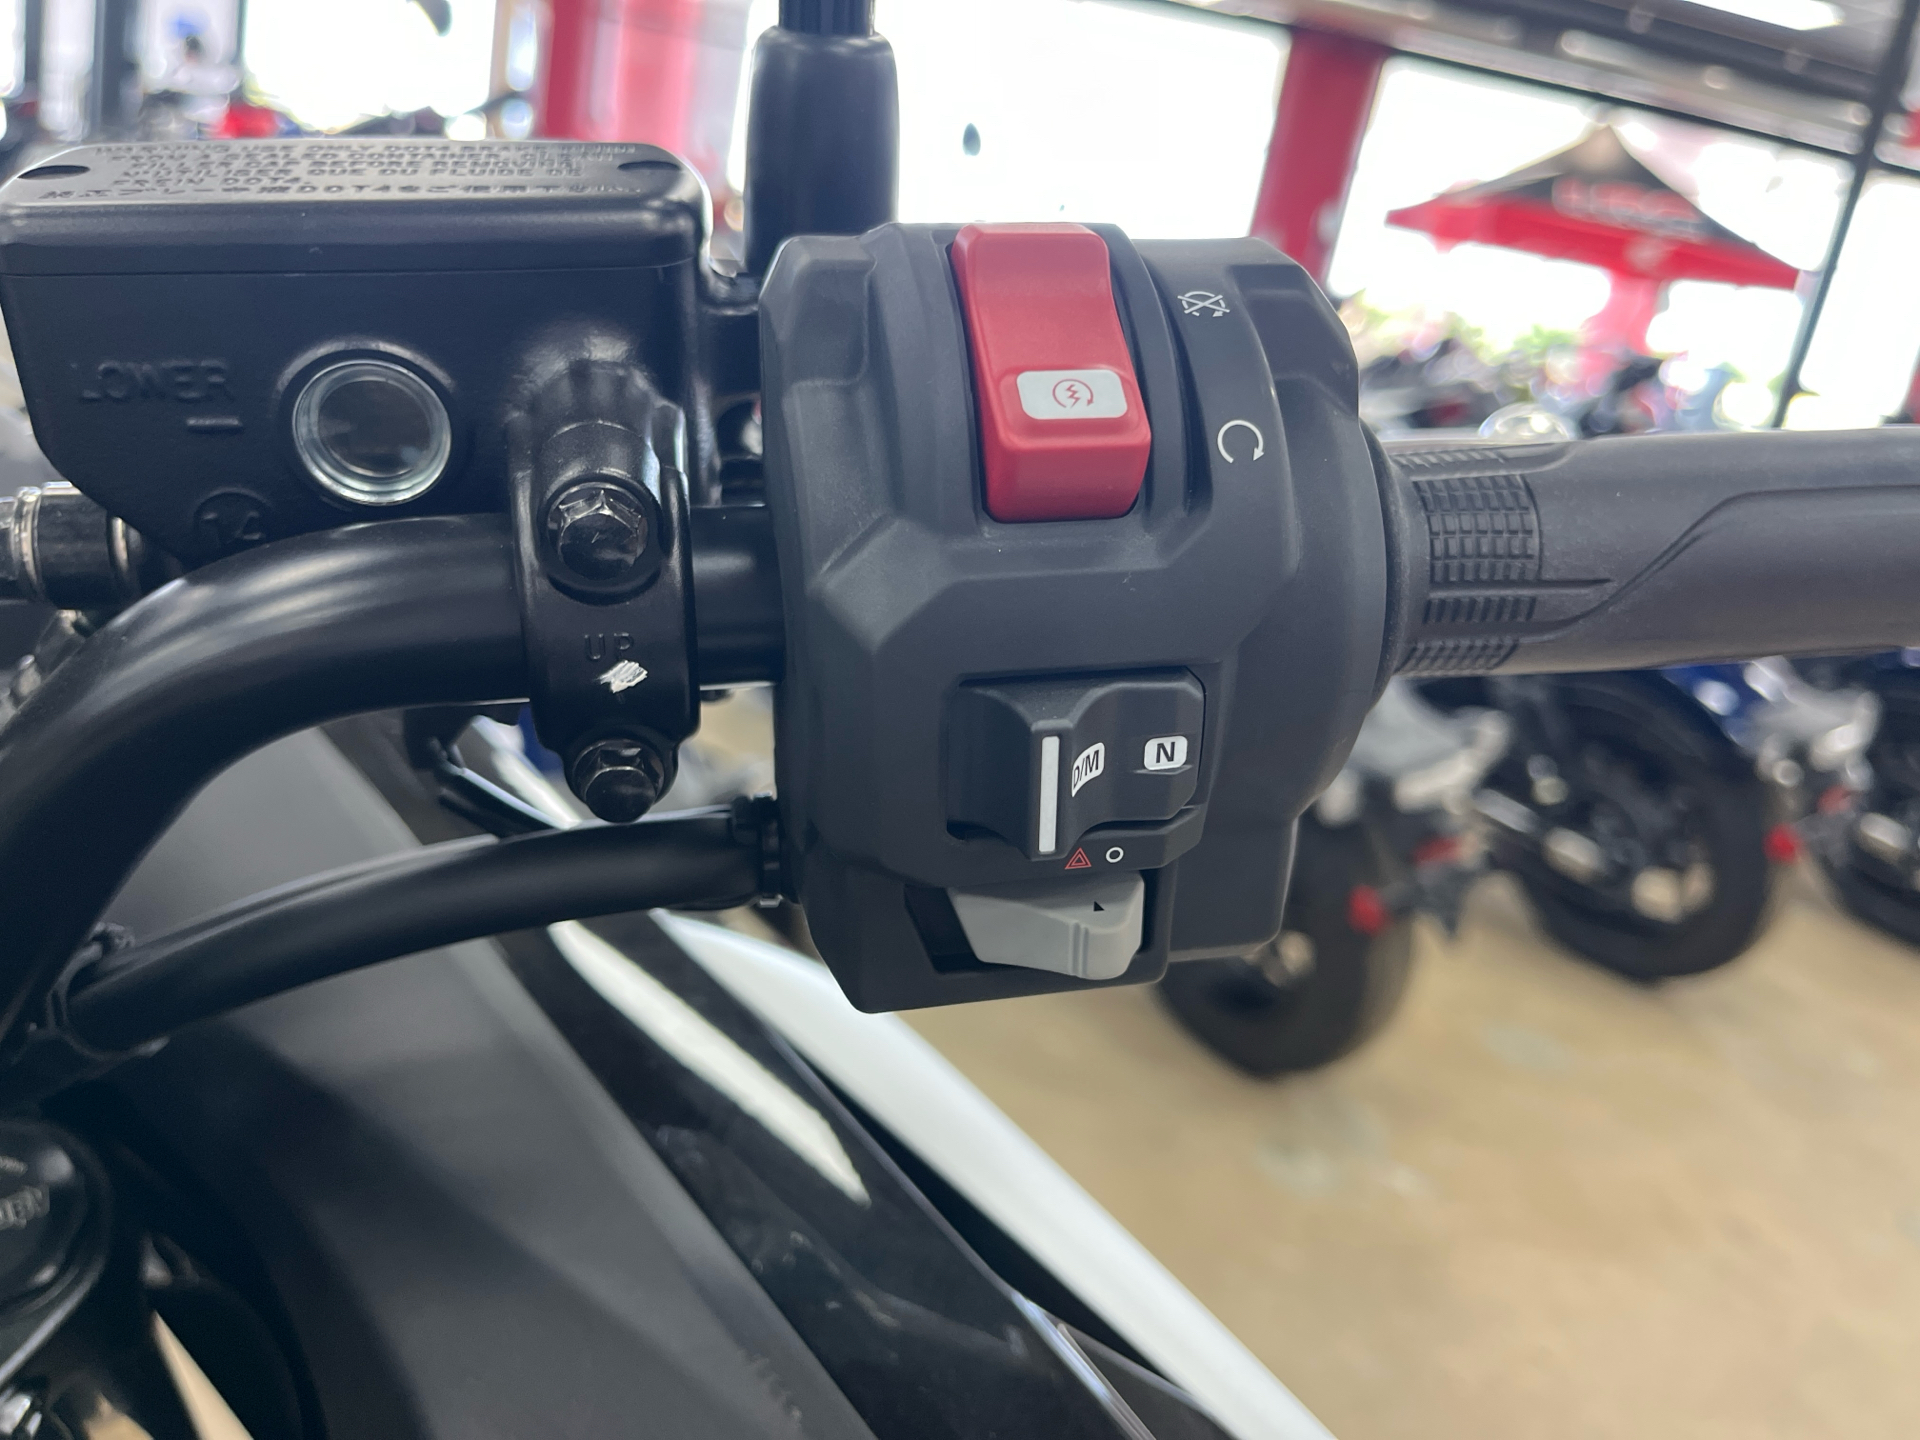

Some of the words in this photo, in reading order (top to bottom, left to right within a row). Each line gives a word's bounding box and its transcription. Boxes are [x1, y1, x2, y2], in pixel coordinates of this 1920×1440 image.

[72, 358, 234, 404] LOWER
[582, 632, 634, 662] UP
[1071, 749, 1099, 790] D/M
[1154, 741, 1176, 766] N
